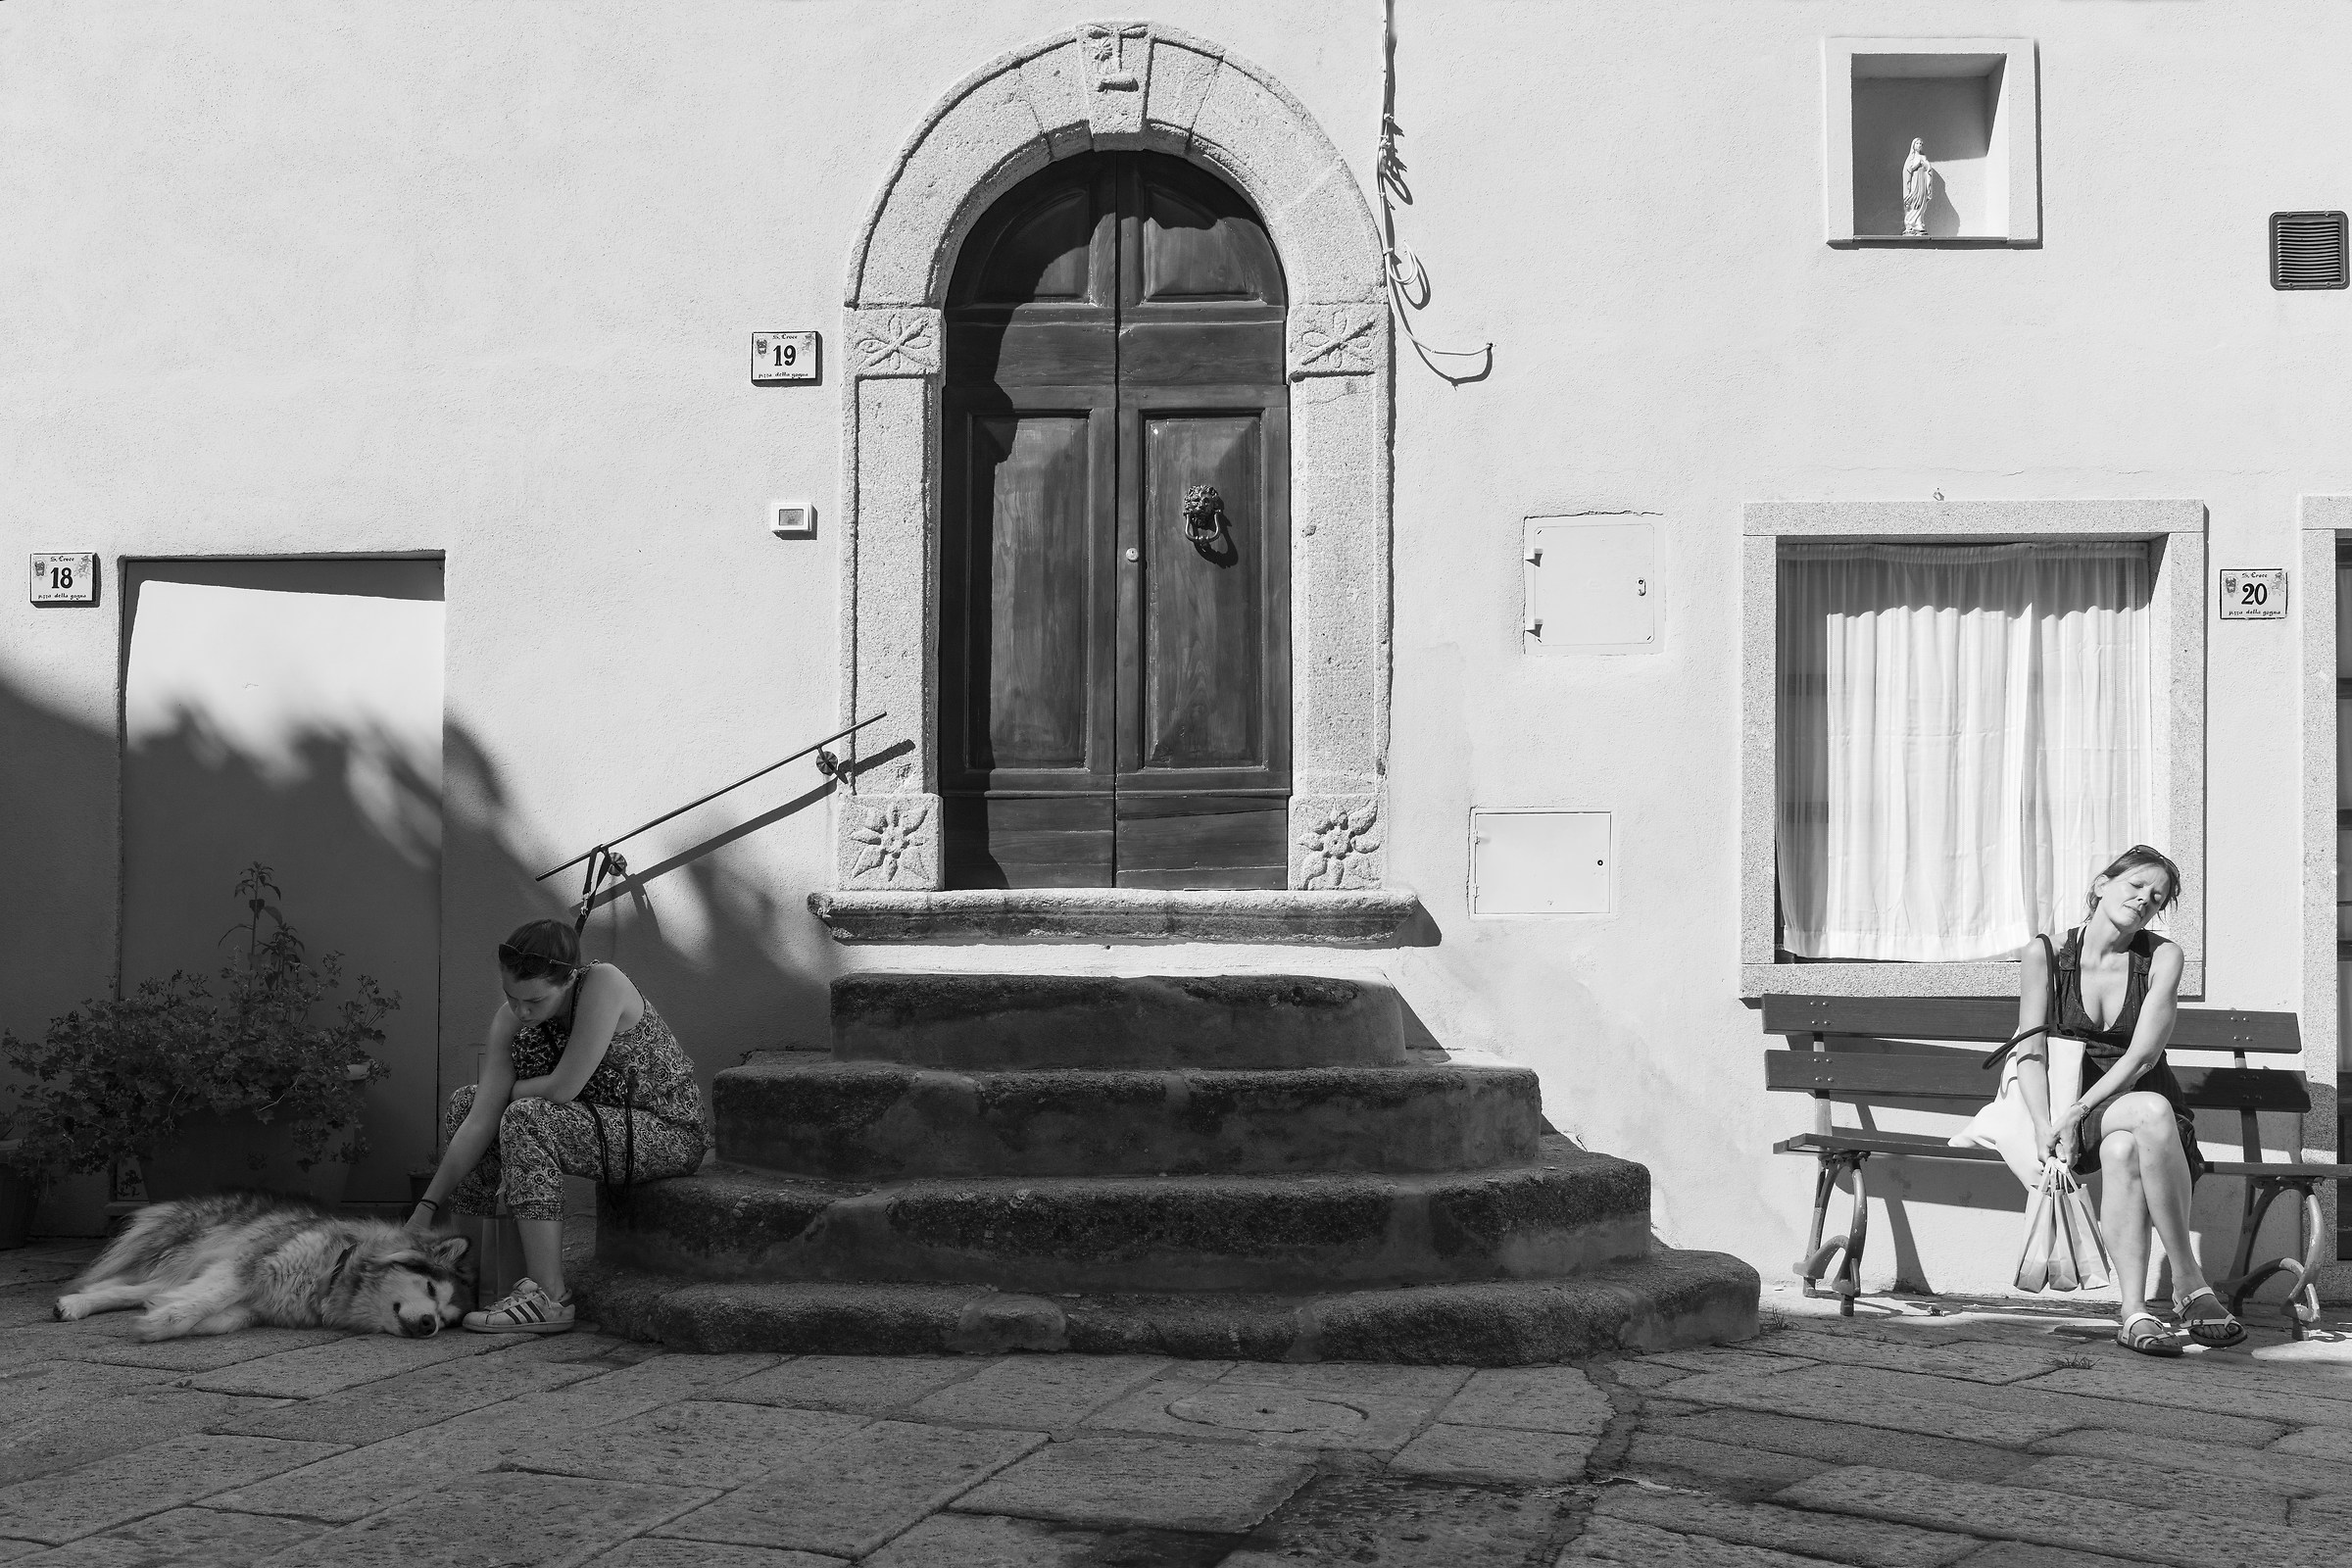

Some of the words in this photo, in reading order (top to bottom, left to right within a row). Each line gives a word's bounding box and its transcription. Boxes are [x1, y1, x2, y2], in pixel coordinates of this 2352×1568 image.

[773, 345, 796, 367] 19
[50, 567, 73, 589] 18
[2241, 583, 2268, 606] 20
